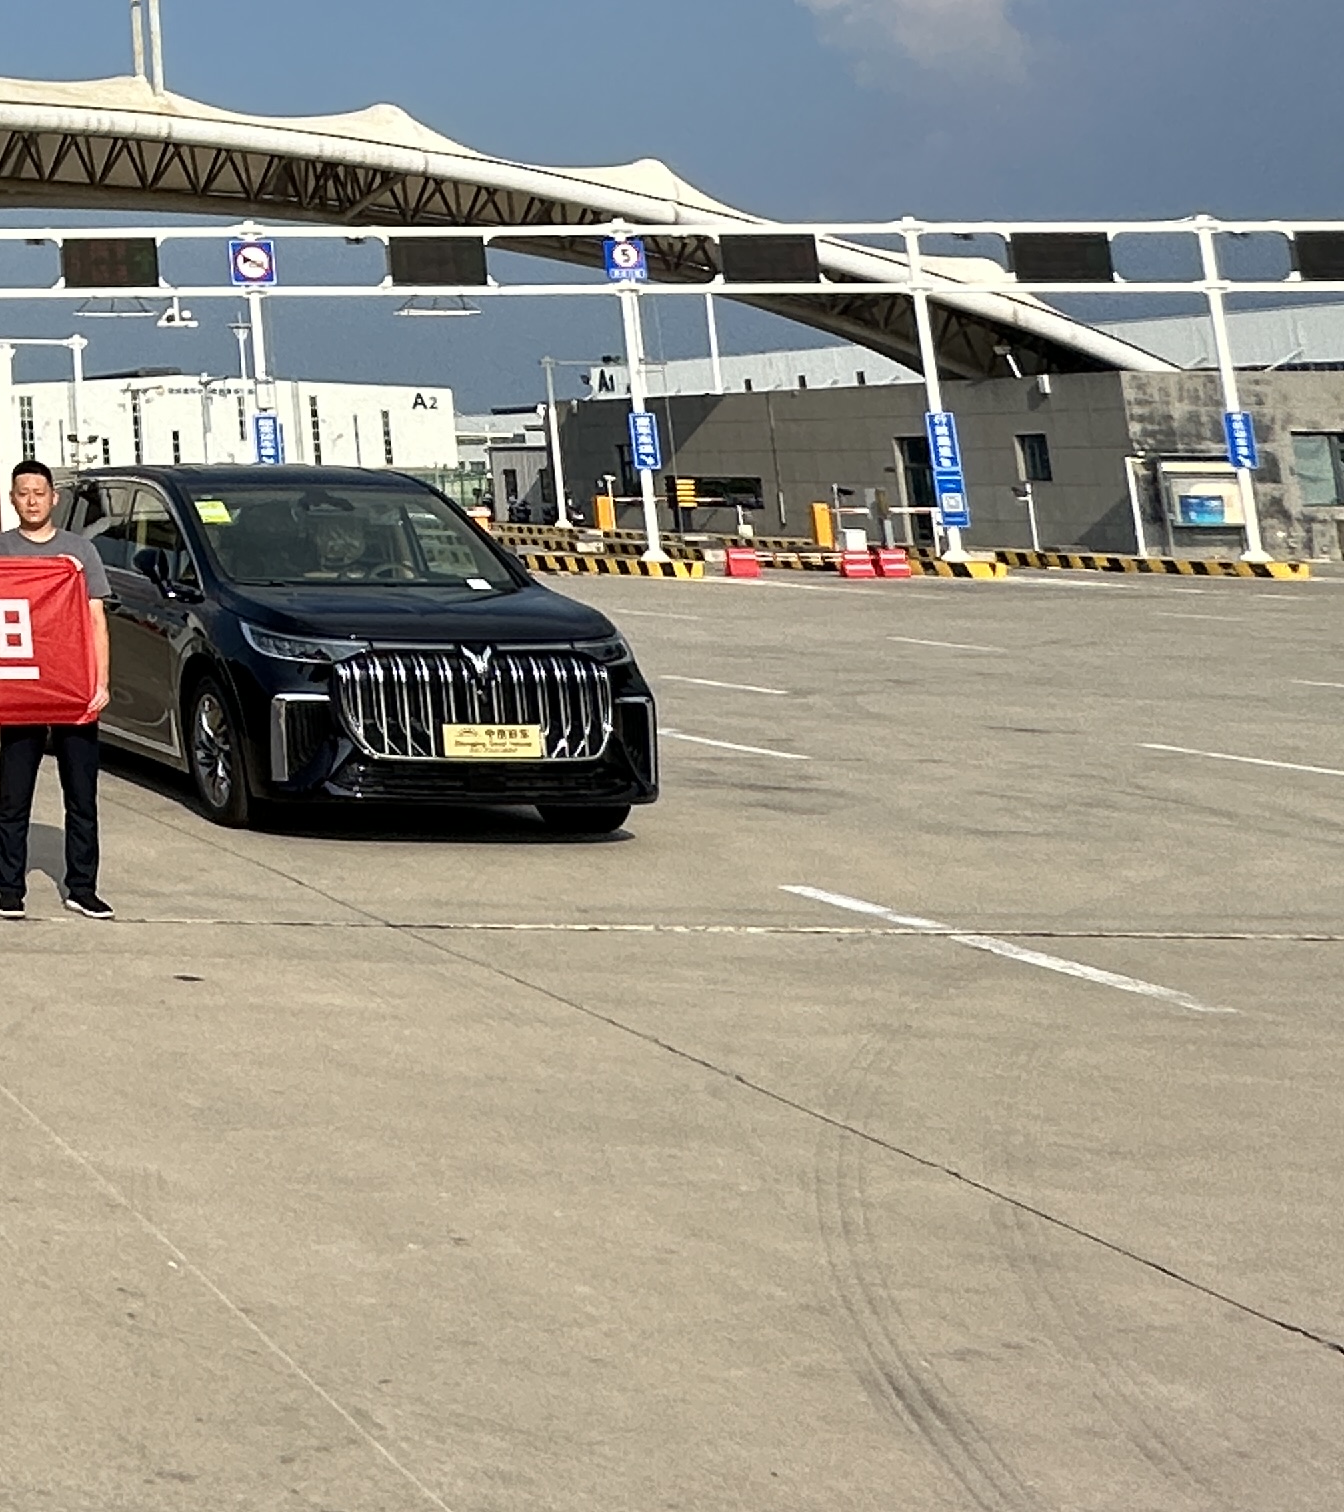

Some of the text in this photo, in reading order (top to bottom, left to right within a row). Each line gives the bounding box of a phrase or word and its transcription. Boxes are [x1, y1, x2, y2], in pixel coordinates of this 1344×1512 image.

[620, 248, 631, 263] 5
[598, 368, 615, 392] A1
[411, 392, 438, 410] A2
